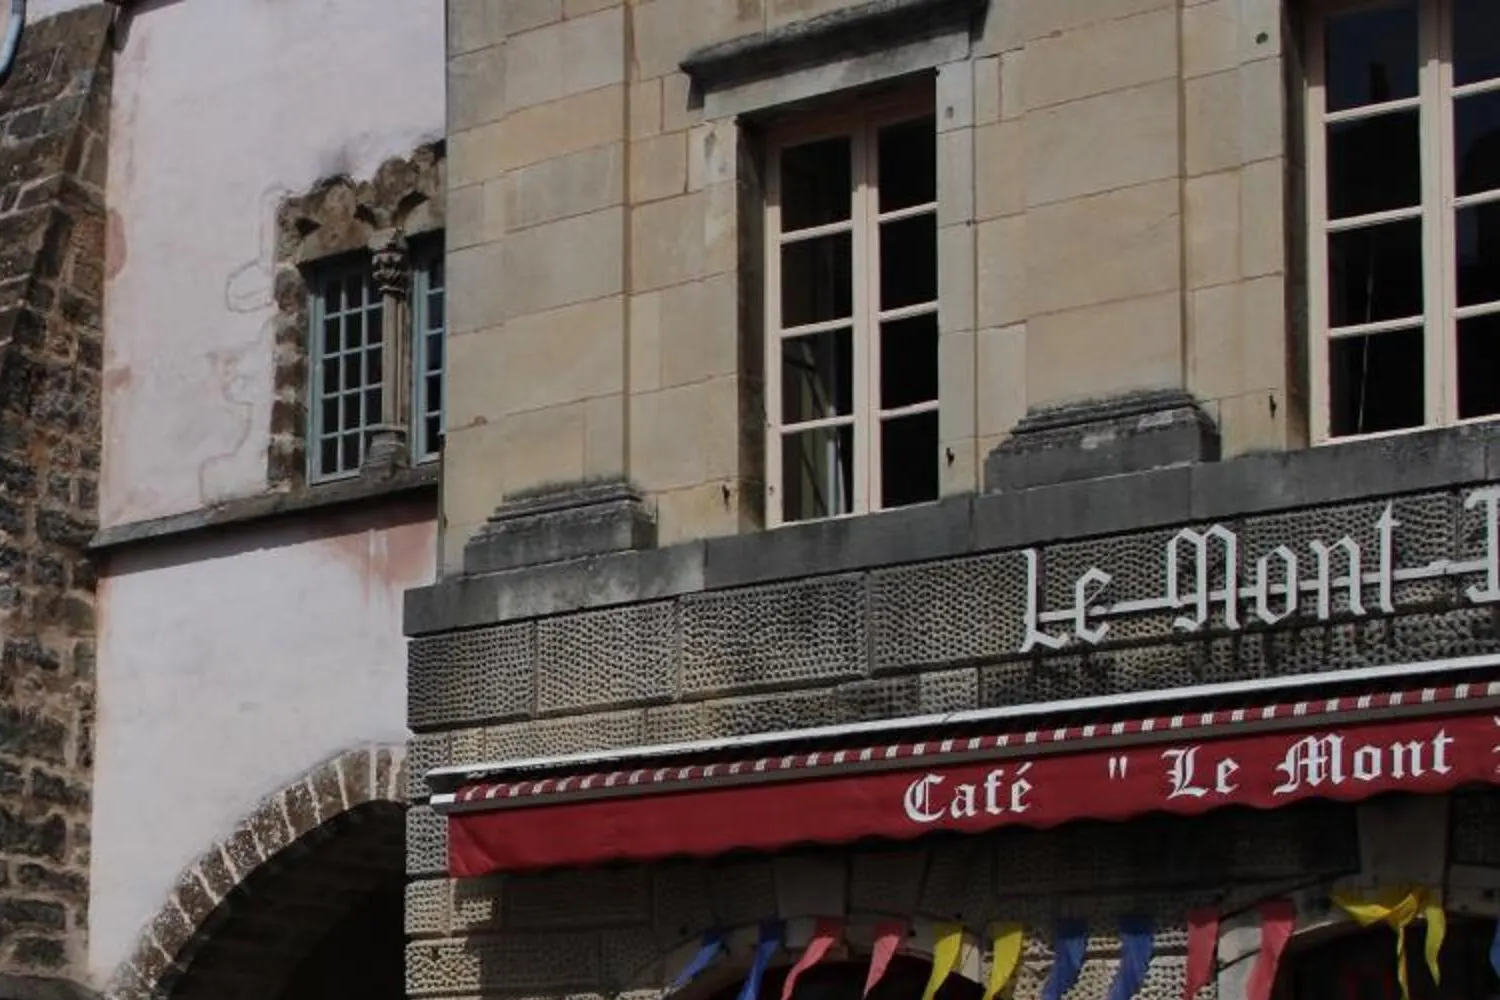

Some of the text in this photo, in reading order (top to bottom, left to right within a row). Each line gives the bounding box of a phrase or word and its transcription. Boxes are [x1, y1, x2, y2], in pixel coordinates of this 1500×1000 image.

[1021, 547, 1112, 653] Le
[1166, 500, 1401, 631] Mont
[903, 761, 1034, 823] Café
[1162, 744, 1241, 800] Le
[1272, 728, 1455, 797] Mont
